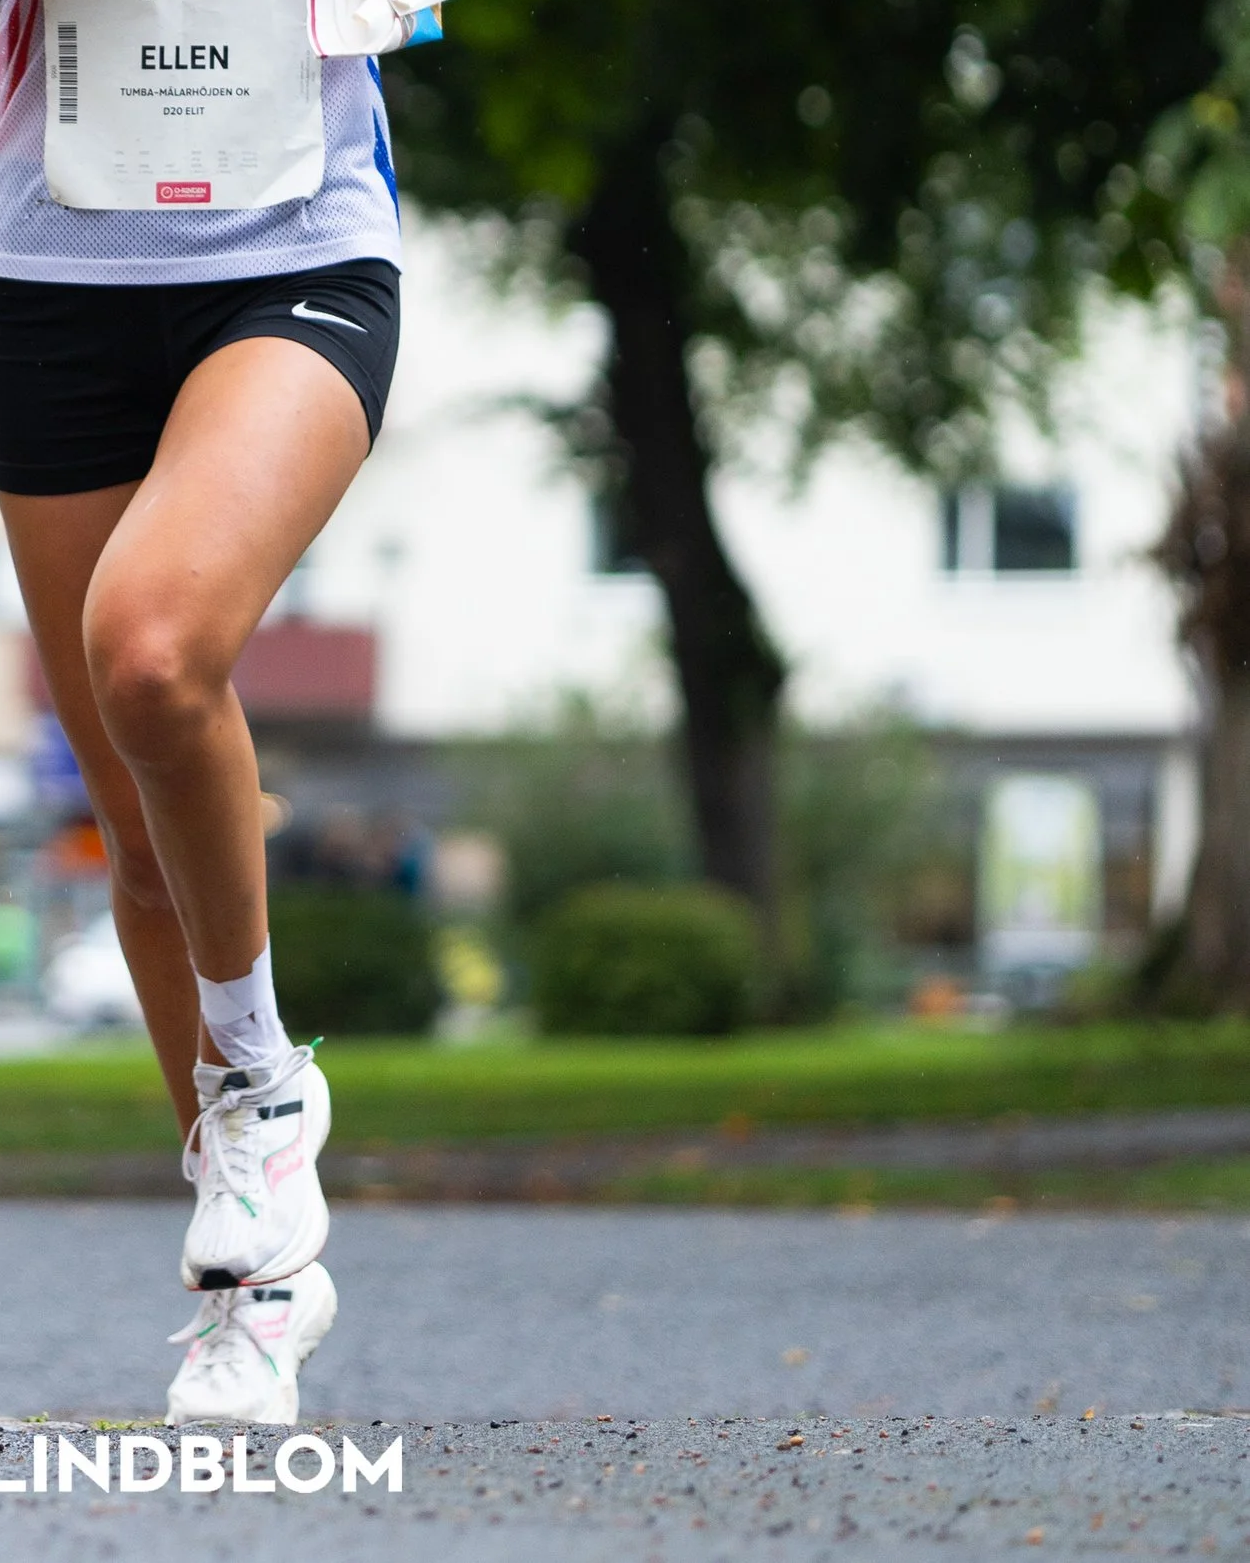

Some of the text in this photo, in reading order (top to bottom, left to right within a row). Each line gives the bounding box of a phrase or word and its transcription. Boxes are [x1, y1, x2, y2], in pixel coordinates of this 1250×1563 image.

[141, 45, 229, 70] ELLEN
[235, 87, 250, 96] OK
[163, 106, 204, 115] D20 ELIT
